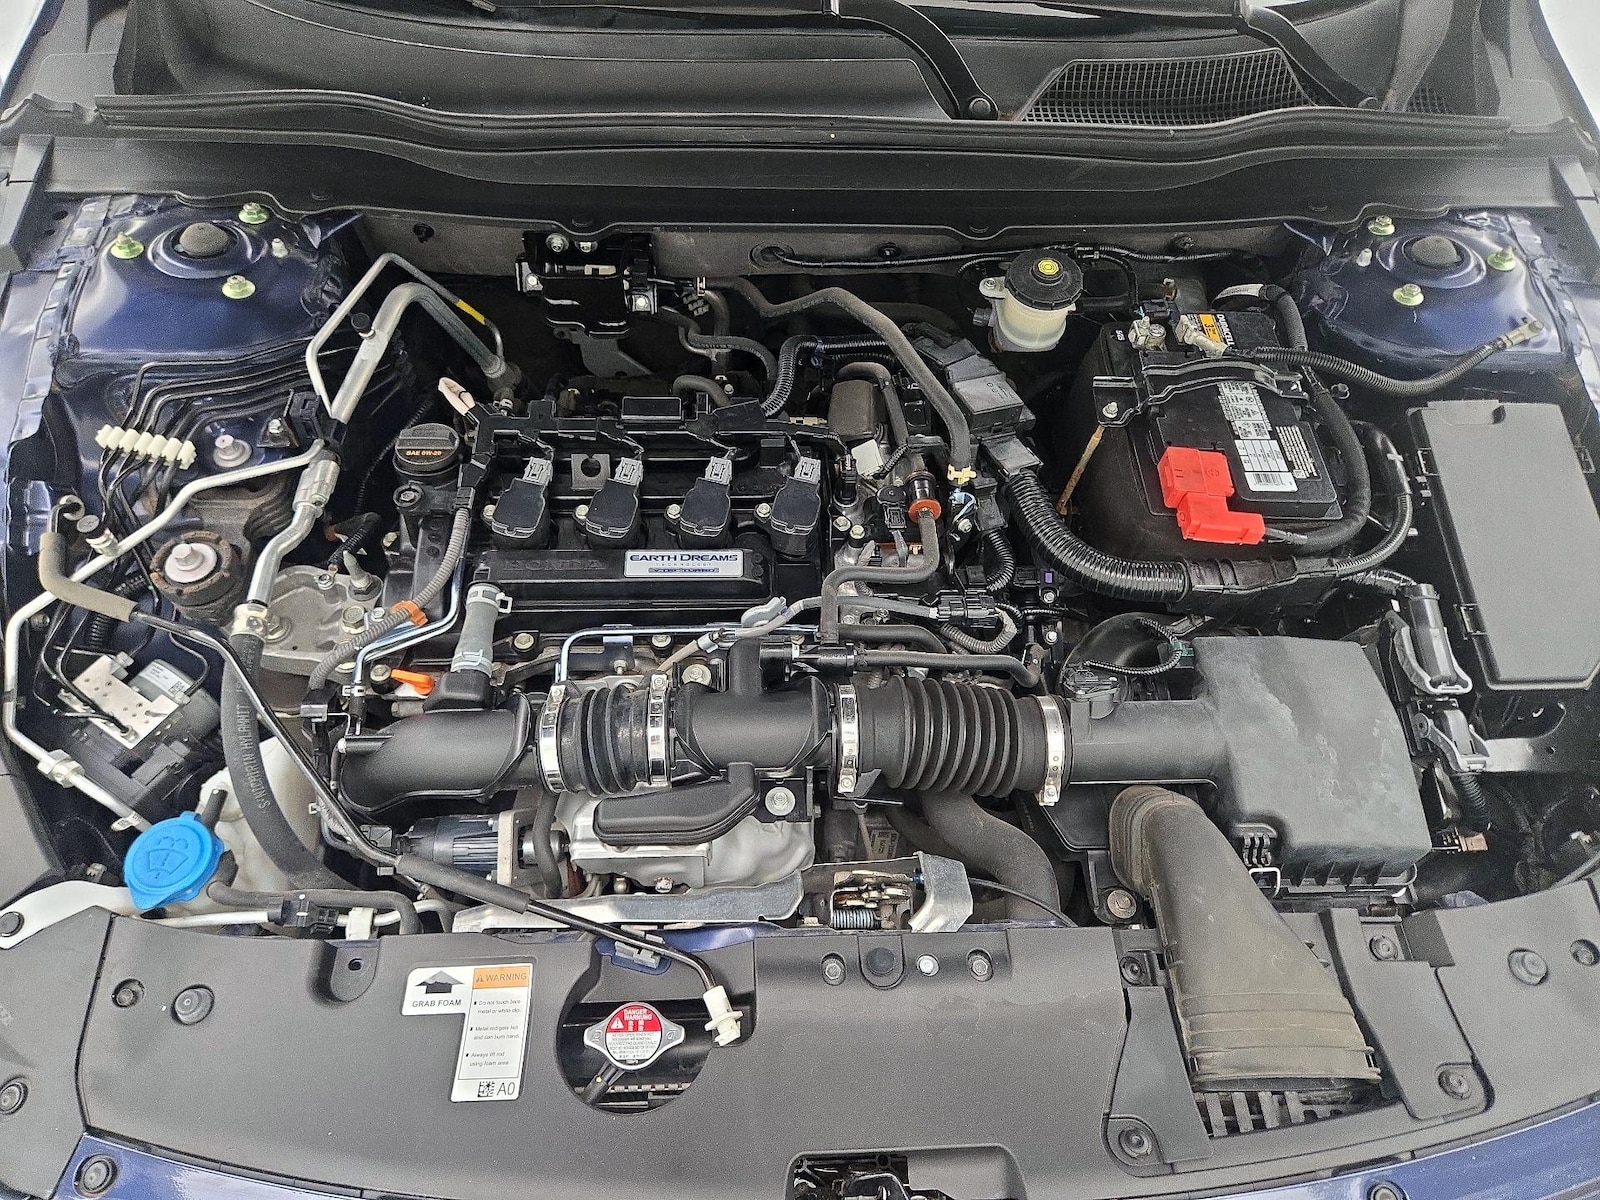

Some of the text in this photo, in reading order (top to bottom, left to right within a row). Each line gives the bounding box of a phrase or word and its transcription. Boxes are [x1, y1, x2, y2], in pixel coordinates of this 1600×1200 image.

[1216, 313, 1236, 347] DURACELL
[629, 553, 738, 562] EARTH DREAMS
[503, 559, 606, 571] HONDA
[485, 972, 527, 982] WARNING
[412, 999, 462, 1008] GRAB FOAM
[496, 1082, 515, 1096] A0
